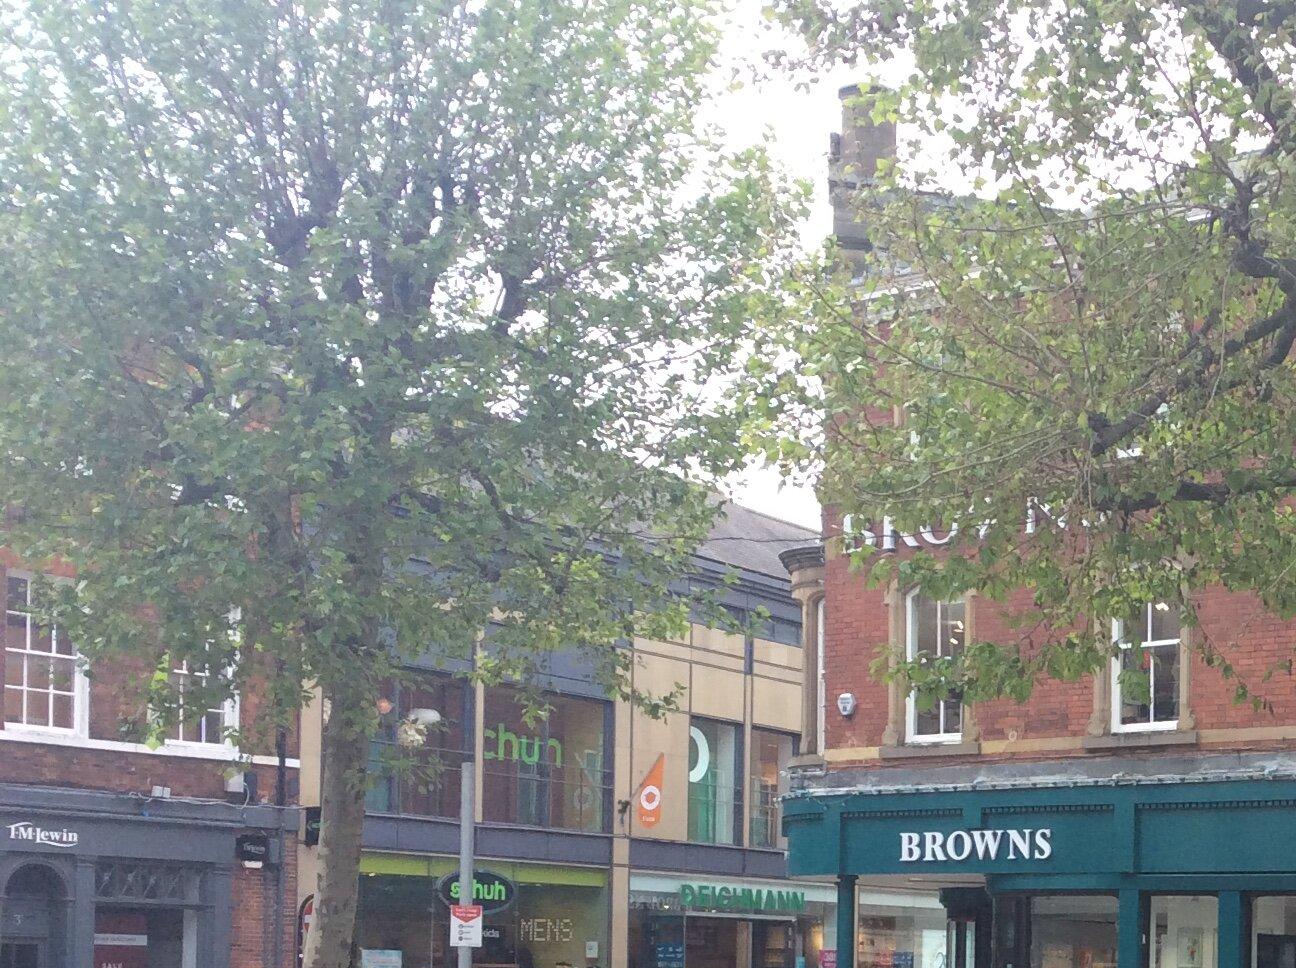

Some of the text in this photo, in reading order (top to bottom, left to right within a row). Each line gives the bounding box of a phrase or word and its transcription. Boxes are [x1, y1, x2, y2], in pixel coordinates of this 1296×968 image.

[899, 828, 1053, 862] BROWNS
[450, 880, 506, 901] shuh
[680, 884, 806, 914] DEICHMANN
[482, 928, 500, 938] ids
[520, 918, 573, 943] MENS
